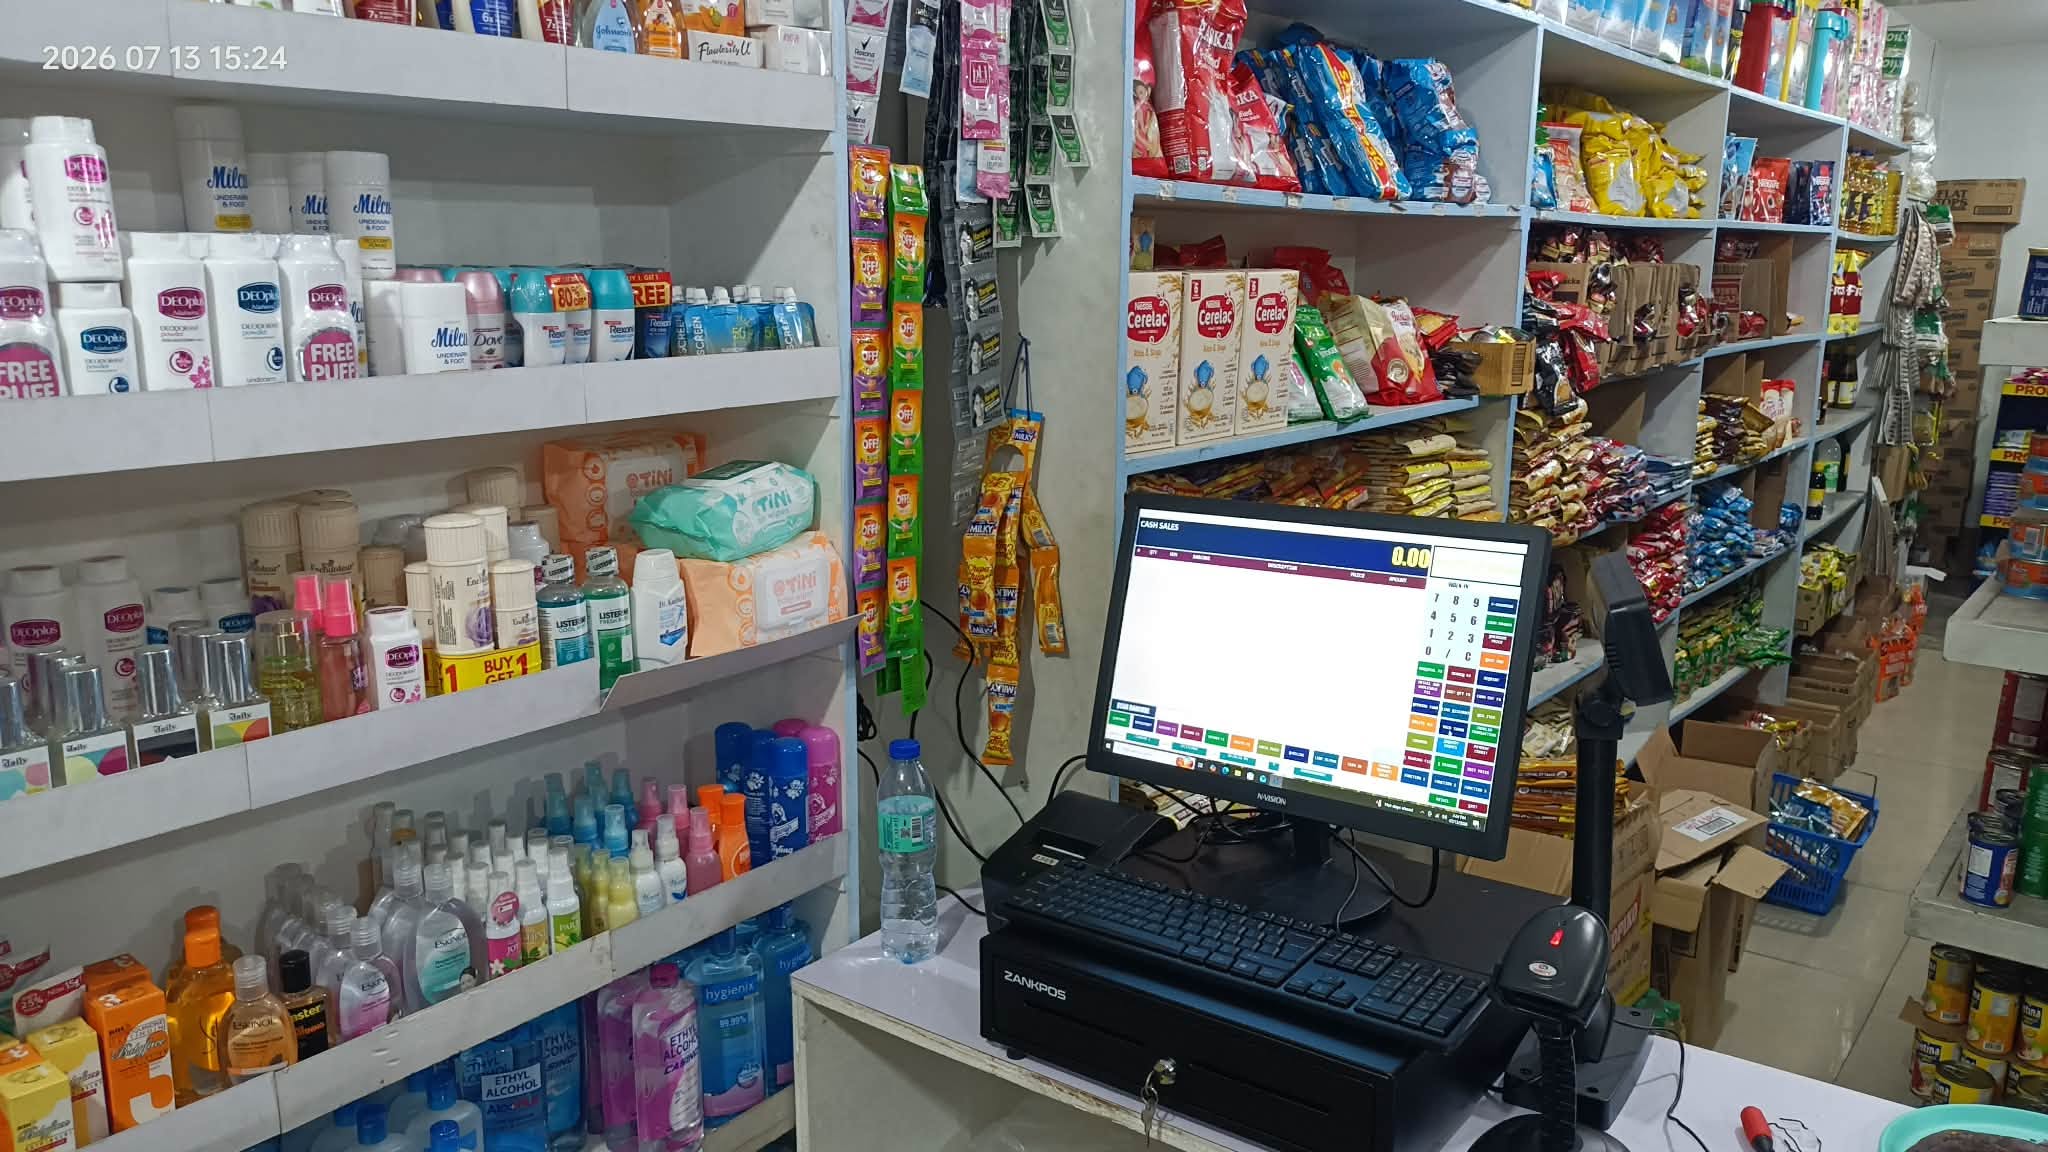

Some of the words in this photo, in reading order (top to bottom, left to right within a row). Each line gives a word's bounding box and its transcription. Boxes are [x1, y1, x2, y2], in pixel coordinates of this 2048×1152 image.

[632, 286, 665, 306] REE
[1127, 311, 1168, 329] Cerelac
[1199, 309, 1233, 326] Cerelac
[1256, 306, 1287, 323] Cerelac
[472, 333, 503, 347] Dove
[311, 343, 353, 362] FREE
[1014, 432, 1034, 441] MILKY
[969, 524, 994, 534] MILKY
[1140, 520, 1159, 529] CASH
[1158, 521, 1180, 531] SALES
[1391, 545, 1431, 569] 0.00
[1434, 593, 1440, 603] 7
[1452, 595, 1460, 605] 8
[1473, 597, 1480, 608] 9
[1430, 610, 1437, 621] 4
[1450, 612, 1457, 623] 5
[1470, 615, 1478, 626] 6
[1429, 628, 1434, 638] 1
[1447, 630, 1454, 641] 2
[1467, 633, 1474, 644] 3
[1425, 646, 1432, 656] 0
[1464, 651, 1472, 662] C
[484, 655, 514, 674] BUY
[705, 981, 754, 1001] hygienix
[1004, 970, 1067, 1001] ZANKPOS
[670, 1023, 697, 1048] ETHYL
[495, 1071, 529, 1086] ETHYL
[486, 1079, 538, 1098] ALCOHOL
